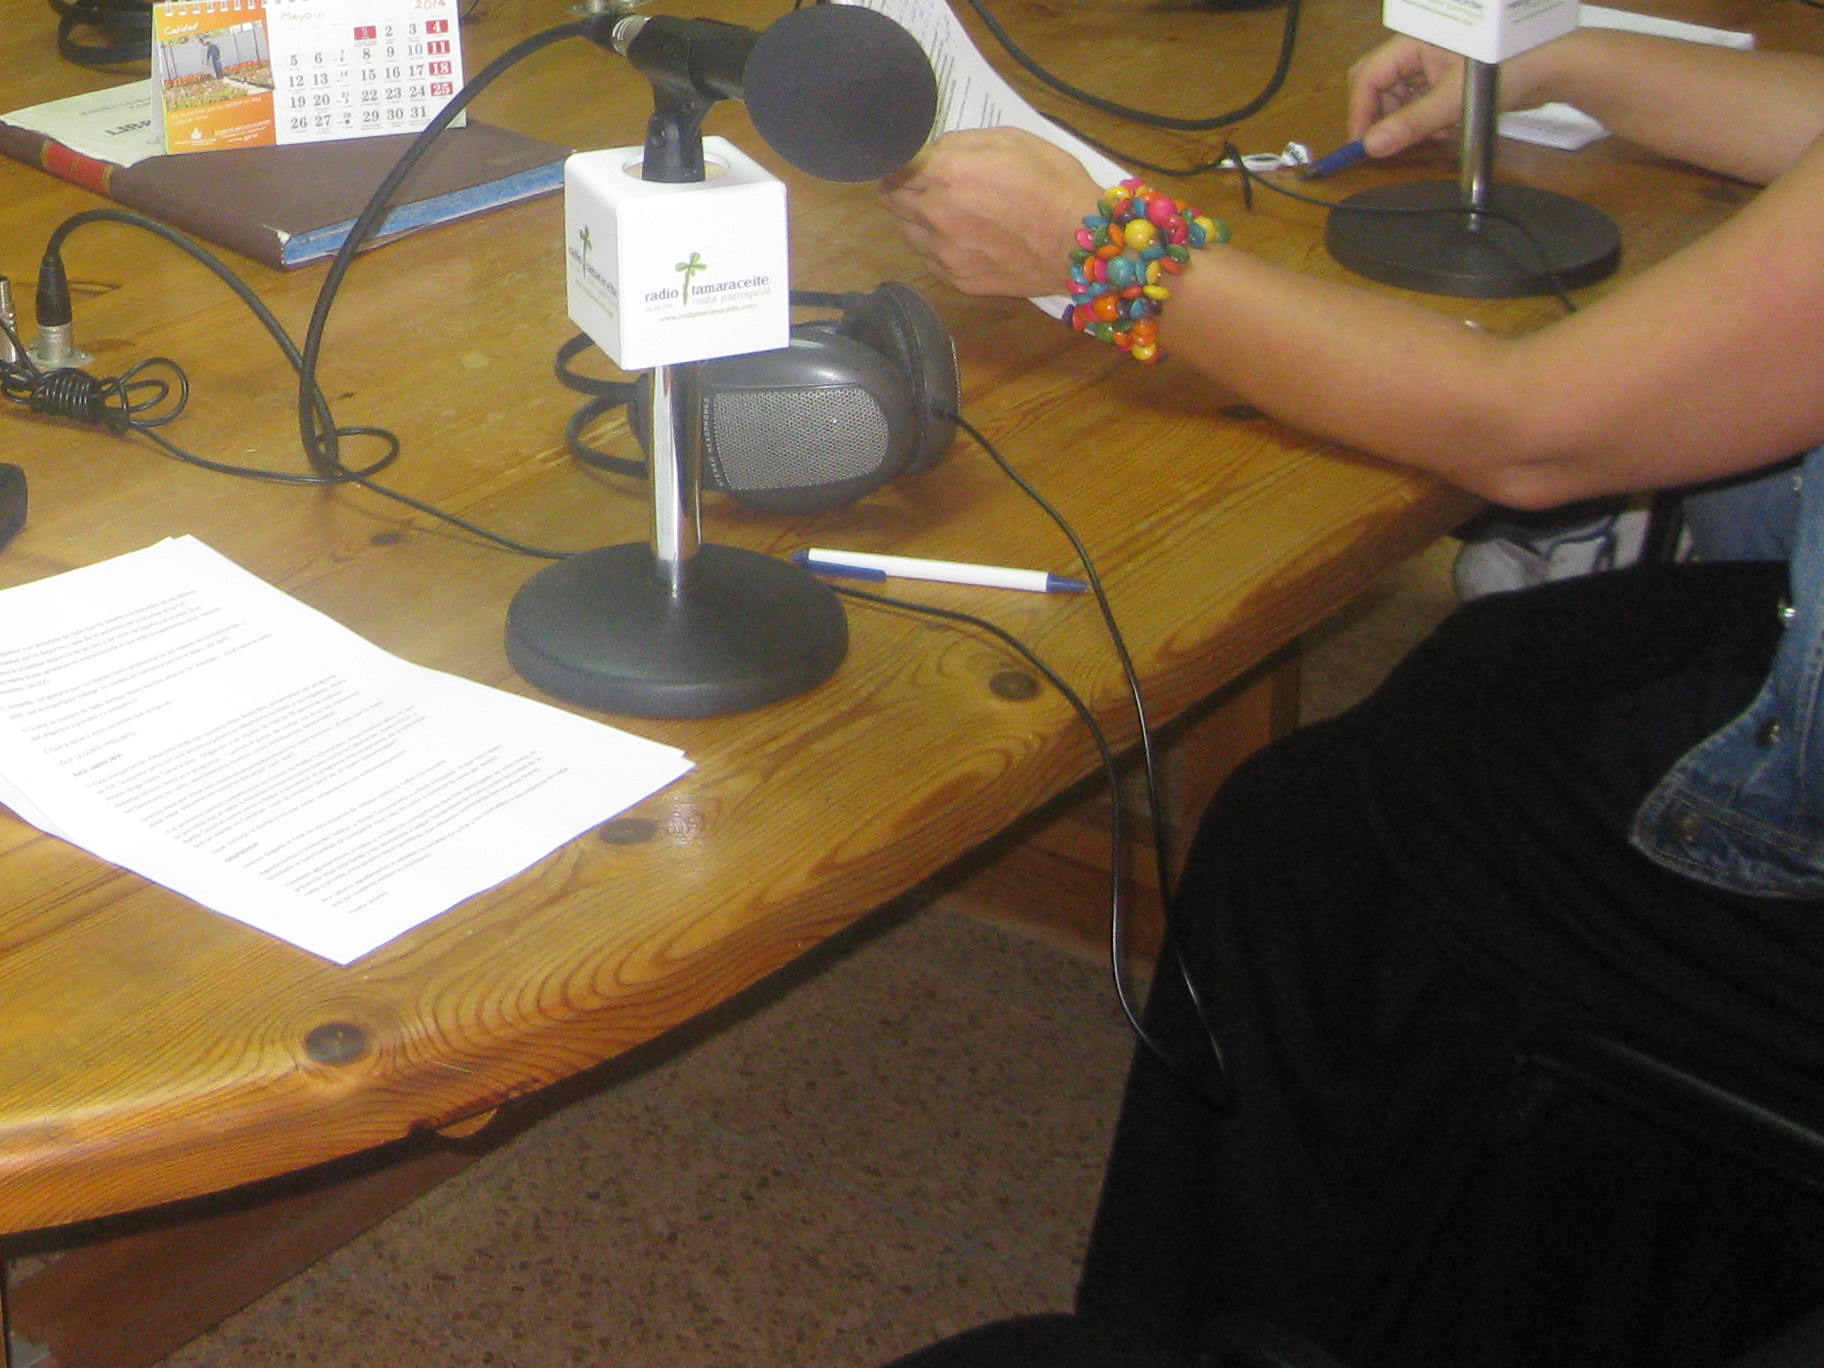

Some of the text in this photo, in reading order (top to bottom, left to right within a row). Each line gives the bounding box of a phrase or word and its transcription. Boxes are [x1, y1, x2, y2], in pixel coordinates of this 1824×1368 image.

[384, 25, 393, 37] 2
[408, 23, 417, 35] 3
[432, 20, 441, 31] 4
[290, 55, 298, 67] 5
[314, 52, 323, 65] 6
[362, 48, 371, 60] 8
[386, 46, 395, 58] 9
[407, 44, 423, 56] 10
[432, 41, 446, 53] 11
[288, 75, 305, 87] 12
[312, 73, 329, 86] 13
[361, 69, 377, 81] 15
[385, 67, 401, 79] 16
[409, 64, 425, 77] 17
[432, 62, 450, 75] 18
[290, 96, 306, 109] 19
[313, 94, 331, 107] 20
[361, 89, 378, 102] 22
[385, 87, 402, 100] 23
[409, 85, 426, 98] 24
[432, 83, 451, 96] 25
[290, 117, 308, 129] 26
[314, 115, 332, 127] 27
[362, 110, 380, 123] 29
[386, 108, 404, 121] 30
[410, 106, 426, 119] 31
[644, 274, 770, 303] radio tamaraceite
